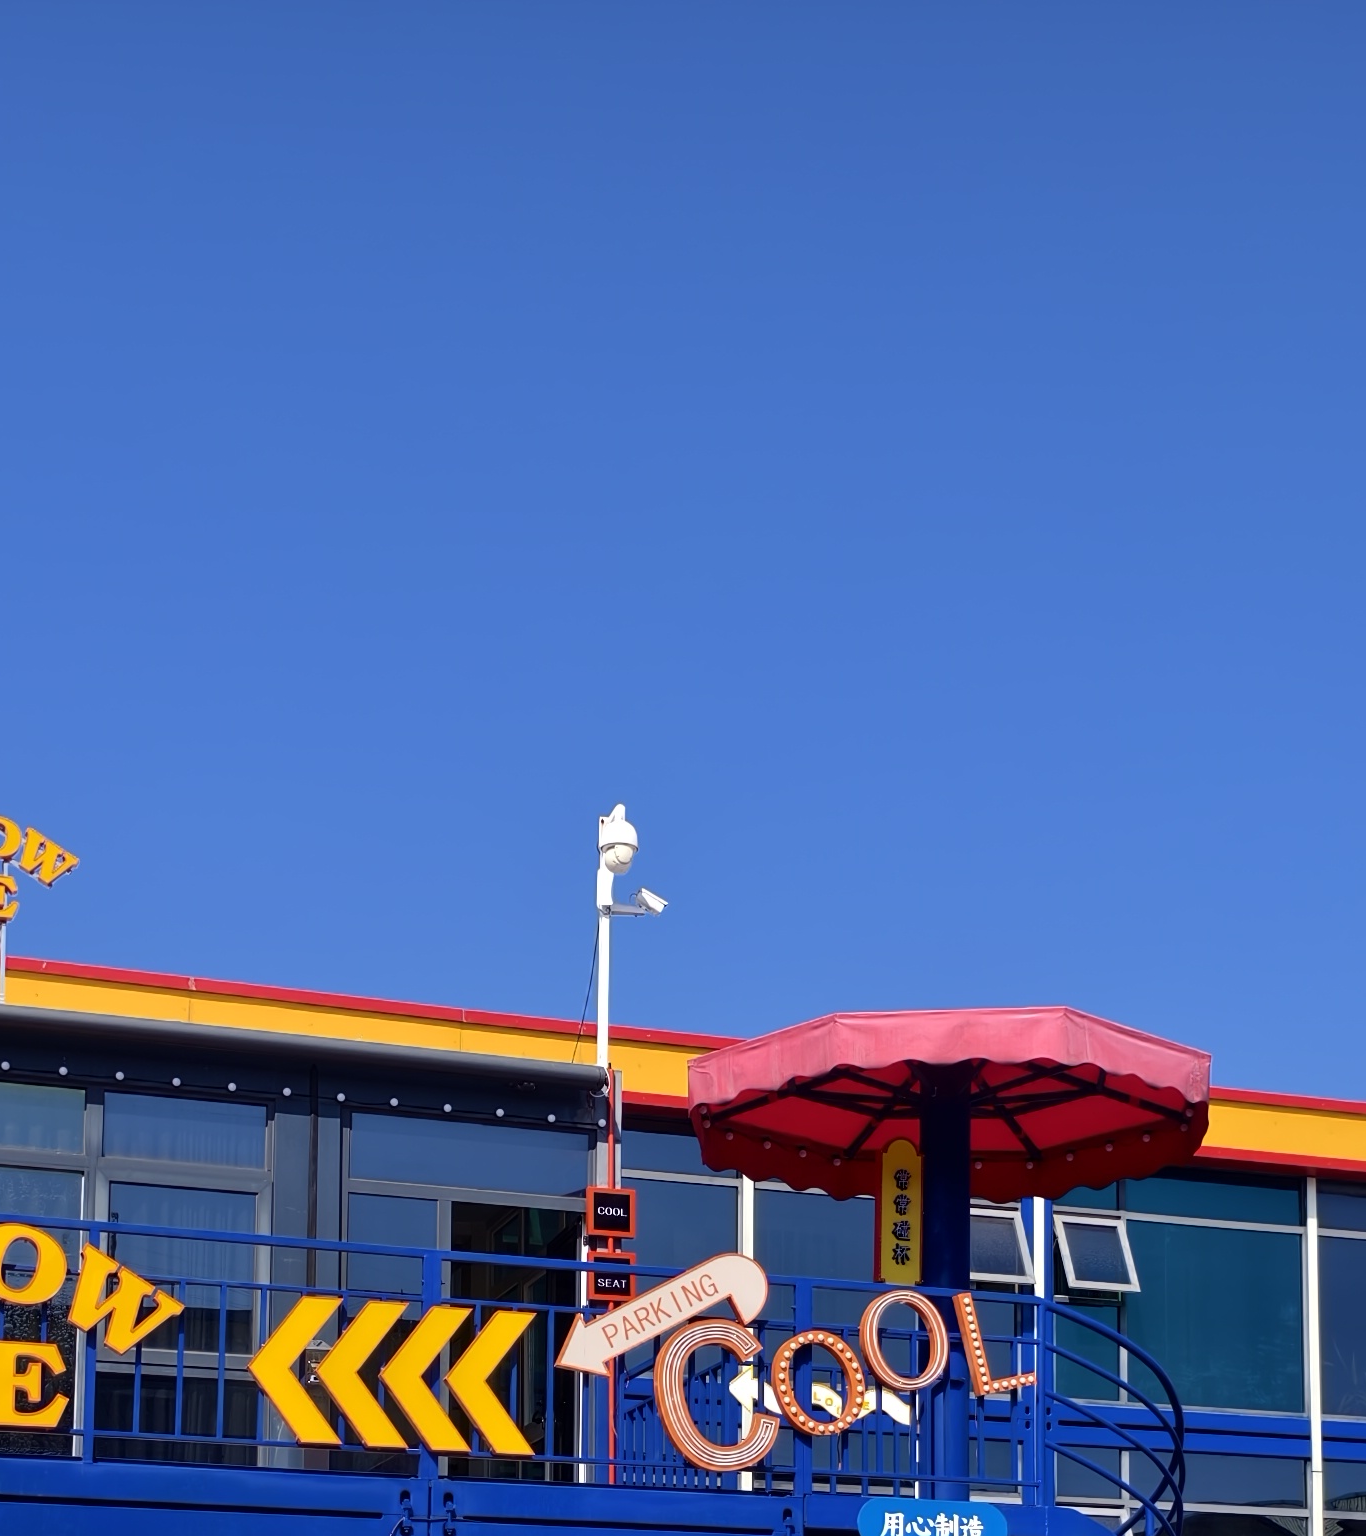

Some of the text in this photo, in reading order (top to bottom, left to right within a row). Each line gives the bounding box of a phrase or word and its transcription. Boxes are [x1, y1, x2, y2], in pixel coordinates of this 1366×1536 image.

[597, 1206, 627, 1217] COOL
[597, 1279, 627, 1288] SEAT
[601, 1274, 719, 1348] PARKING
[653, 1290, 1037, 1471] COOL
